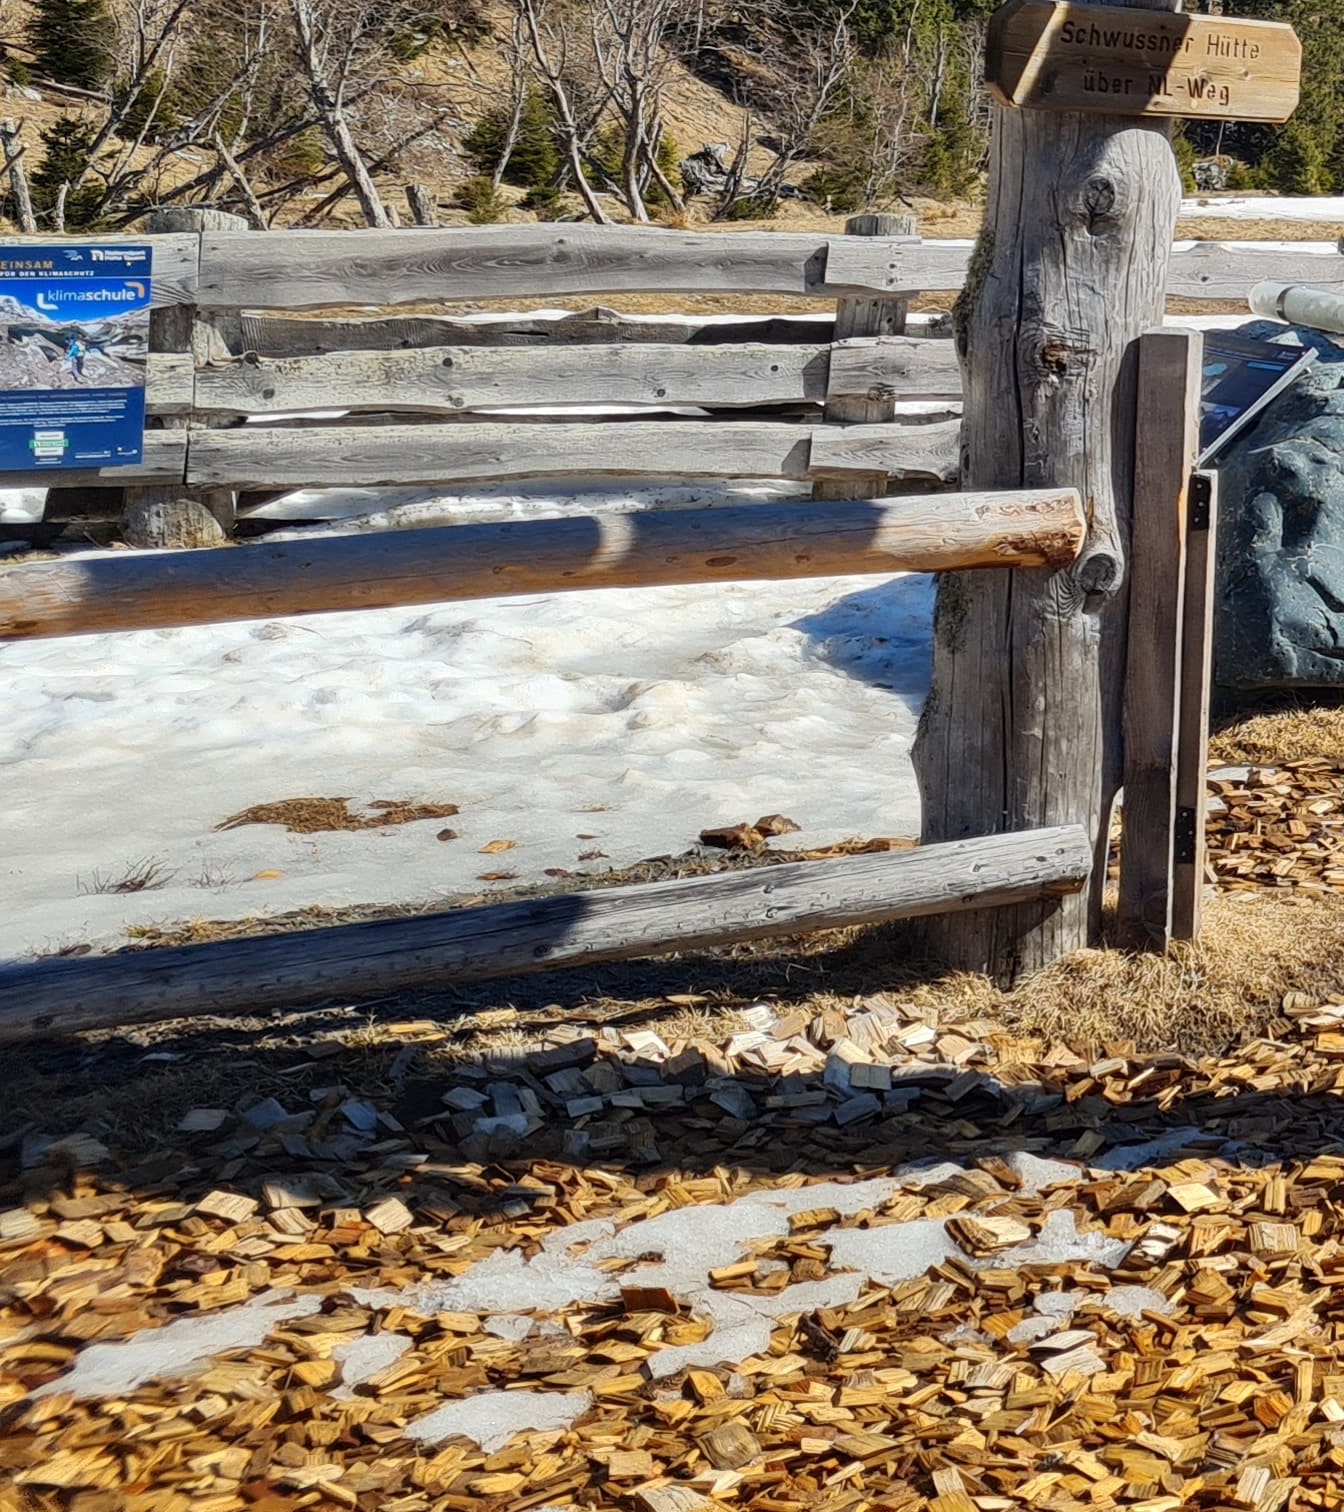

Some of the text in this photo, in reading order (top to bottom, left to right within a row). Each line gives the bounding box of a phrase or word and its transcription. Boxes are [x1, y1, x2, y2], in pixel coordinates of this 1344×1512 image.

[1060, 20, 1261, 60] Schwussner Hütte
[1083, 68, 1231, 106] über NL-Weg
[47, 289, 136, 301] klimaschule
